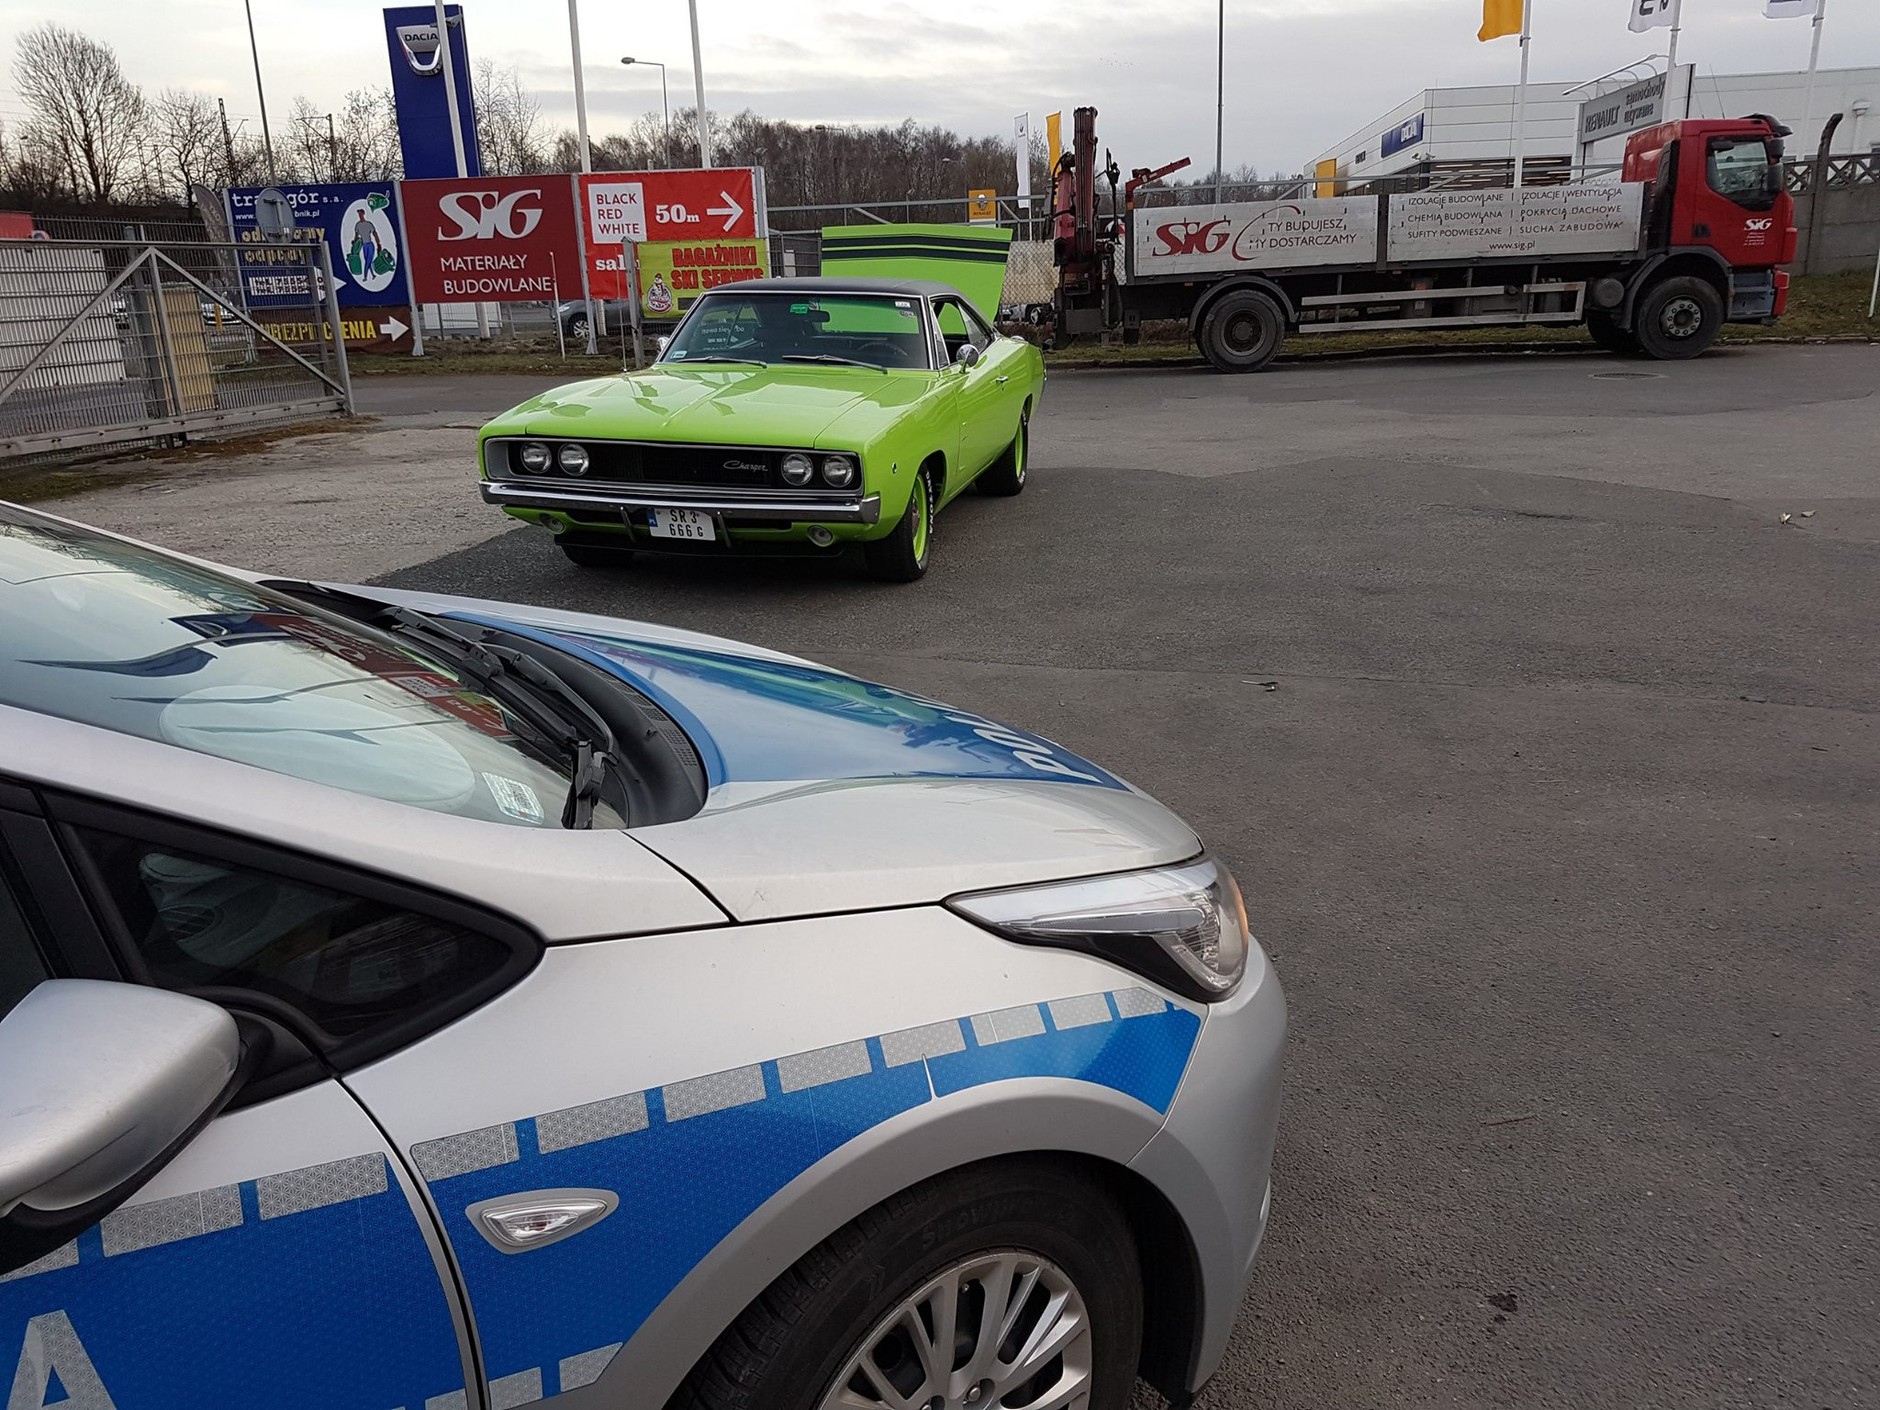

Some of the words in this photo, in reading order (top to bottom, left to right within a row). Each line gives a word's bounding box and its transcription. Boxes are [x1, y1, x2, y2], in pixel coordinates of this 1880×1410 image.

[404, 33, 438, 42] DACIA
[1585, 105, 1620, 133] RENAULT
[596, 193, 637, 205] BLACK
[1408, 196, 1447, 206] IZOLACJE
[1448, 193, 1504, 205] BUDOWLANE
[1521, 191, 1560, 201] IZOLACJE
[1566, 187, 1622, 199] WENTYLACJA
[598, 208, 623, 220] RED
[1407, 214, 1442, 222] CHEMIA
[1444, 210, 1503, 221] BUDOWLANA
[1520, 208, 1567, 217] POKRYCIA
[1571, 205, 1622, 215] DACHOWE
[598, 223, 640, 235] WHITE
[1267, 221, 1283, 233] TY
[1407, 230, 1437, 239] SUFITY
[1439, 226, 1502, 238] PODWIESZANE
[1519, 224, 1555, 234] SUCHA
[1559, 221, 1620, 233] ZABUDOWA
[1269, 233, 1357, 249] DOSTARCZAMY
[1489, 240, 1536, 251] www.sig.pl
[441, 254, 528, 272] MATERIAŁY
[444, 276, 552, 295] BUDOWLANE
[671, 269, 699, 289] SKI
[723, 460, 768, 472] Charger
[669, 509, 687, 523] SR
[690, 510, 698, 524] 3
[669, 523, 693, 537] 666
